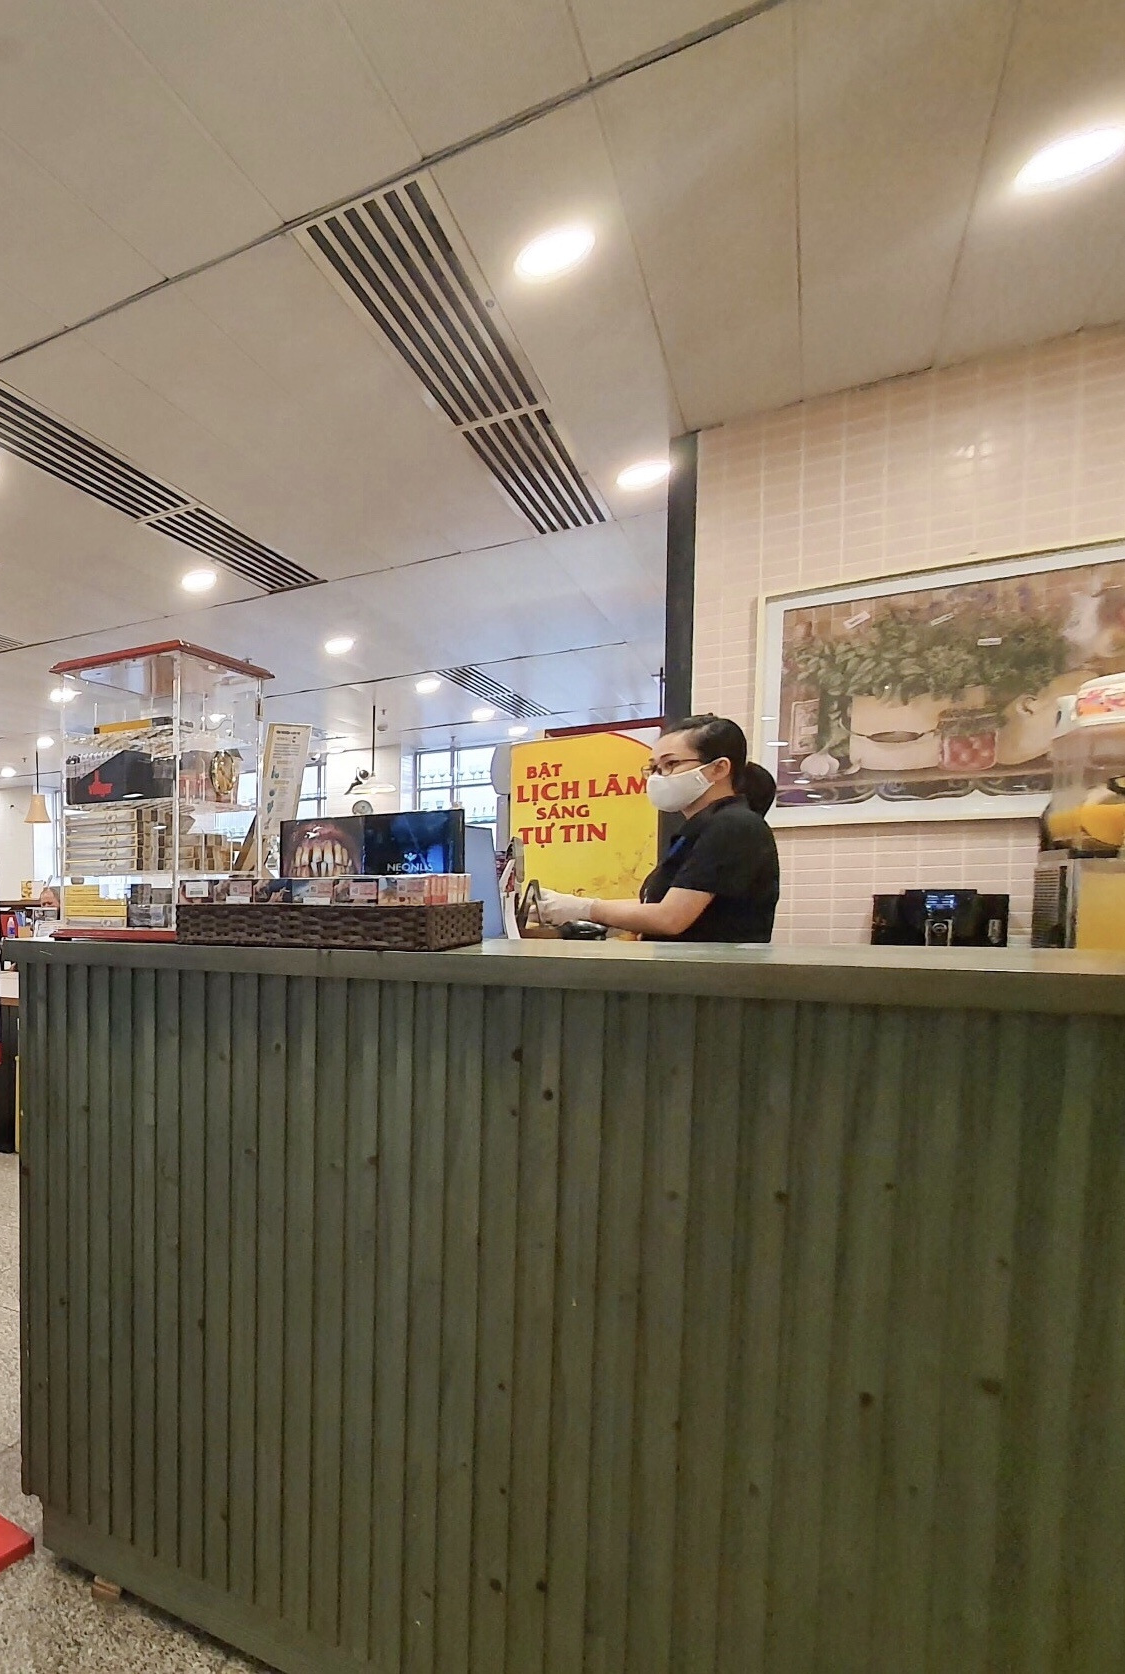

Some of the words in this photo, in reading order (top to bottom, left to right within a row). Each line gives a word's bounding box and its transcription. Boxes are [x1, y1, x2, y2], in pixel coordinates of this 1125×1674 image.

[526, 762, 563, 780] BẬT
[516, 780, 580, 806] LỊCH
[588, 773, 648, 798] LÃM
[536, 803, 590, 820] SÁNG
[518, 822, 556, 848] TỰ
[559, 822, 607, 843] TIN
